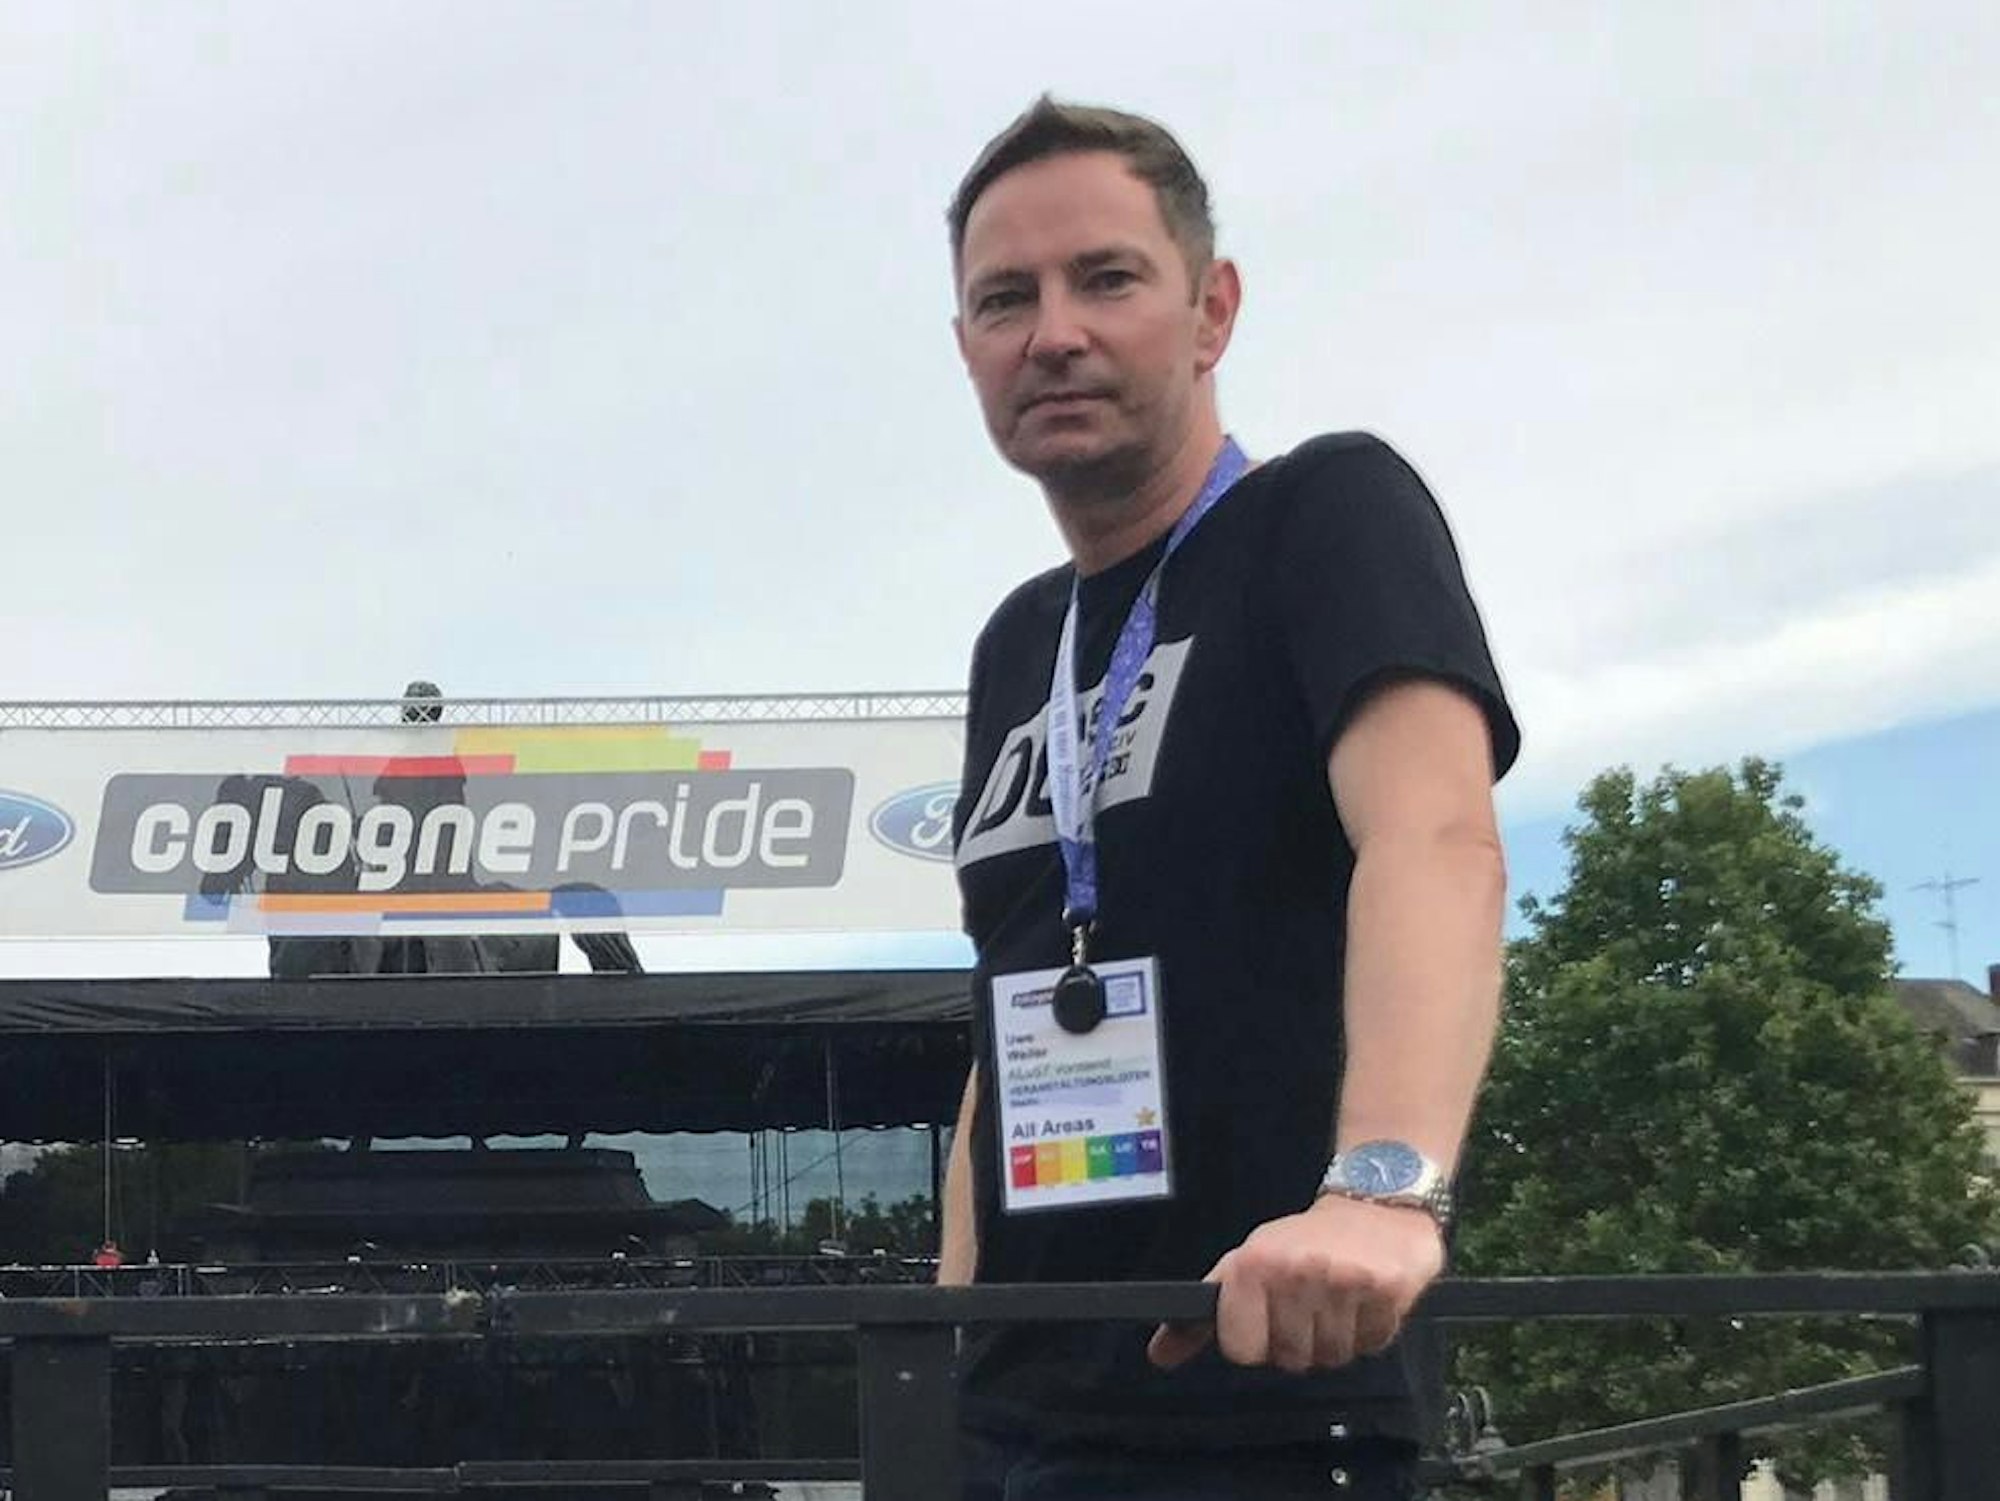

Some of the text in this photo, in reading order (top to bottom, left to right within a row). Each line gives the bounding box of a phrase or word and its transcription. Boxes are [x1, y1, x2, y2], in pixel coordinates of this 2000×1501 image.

[130, 786, 538, 892] cologne
[556, 782, 814, 872] pride
[1011, 1118, 1095, 1139] All Areas
